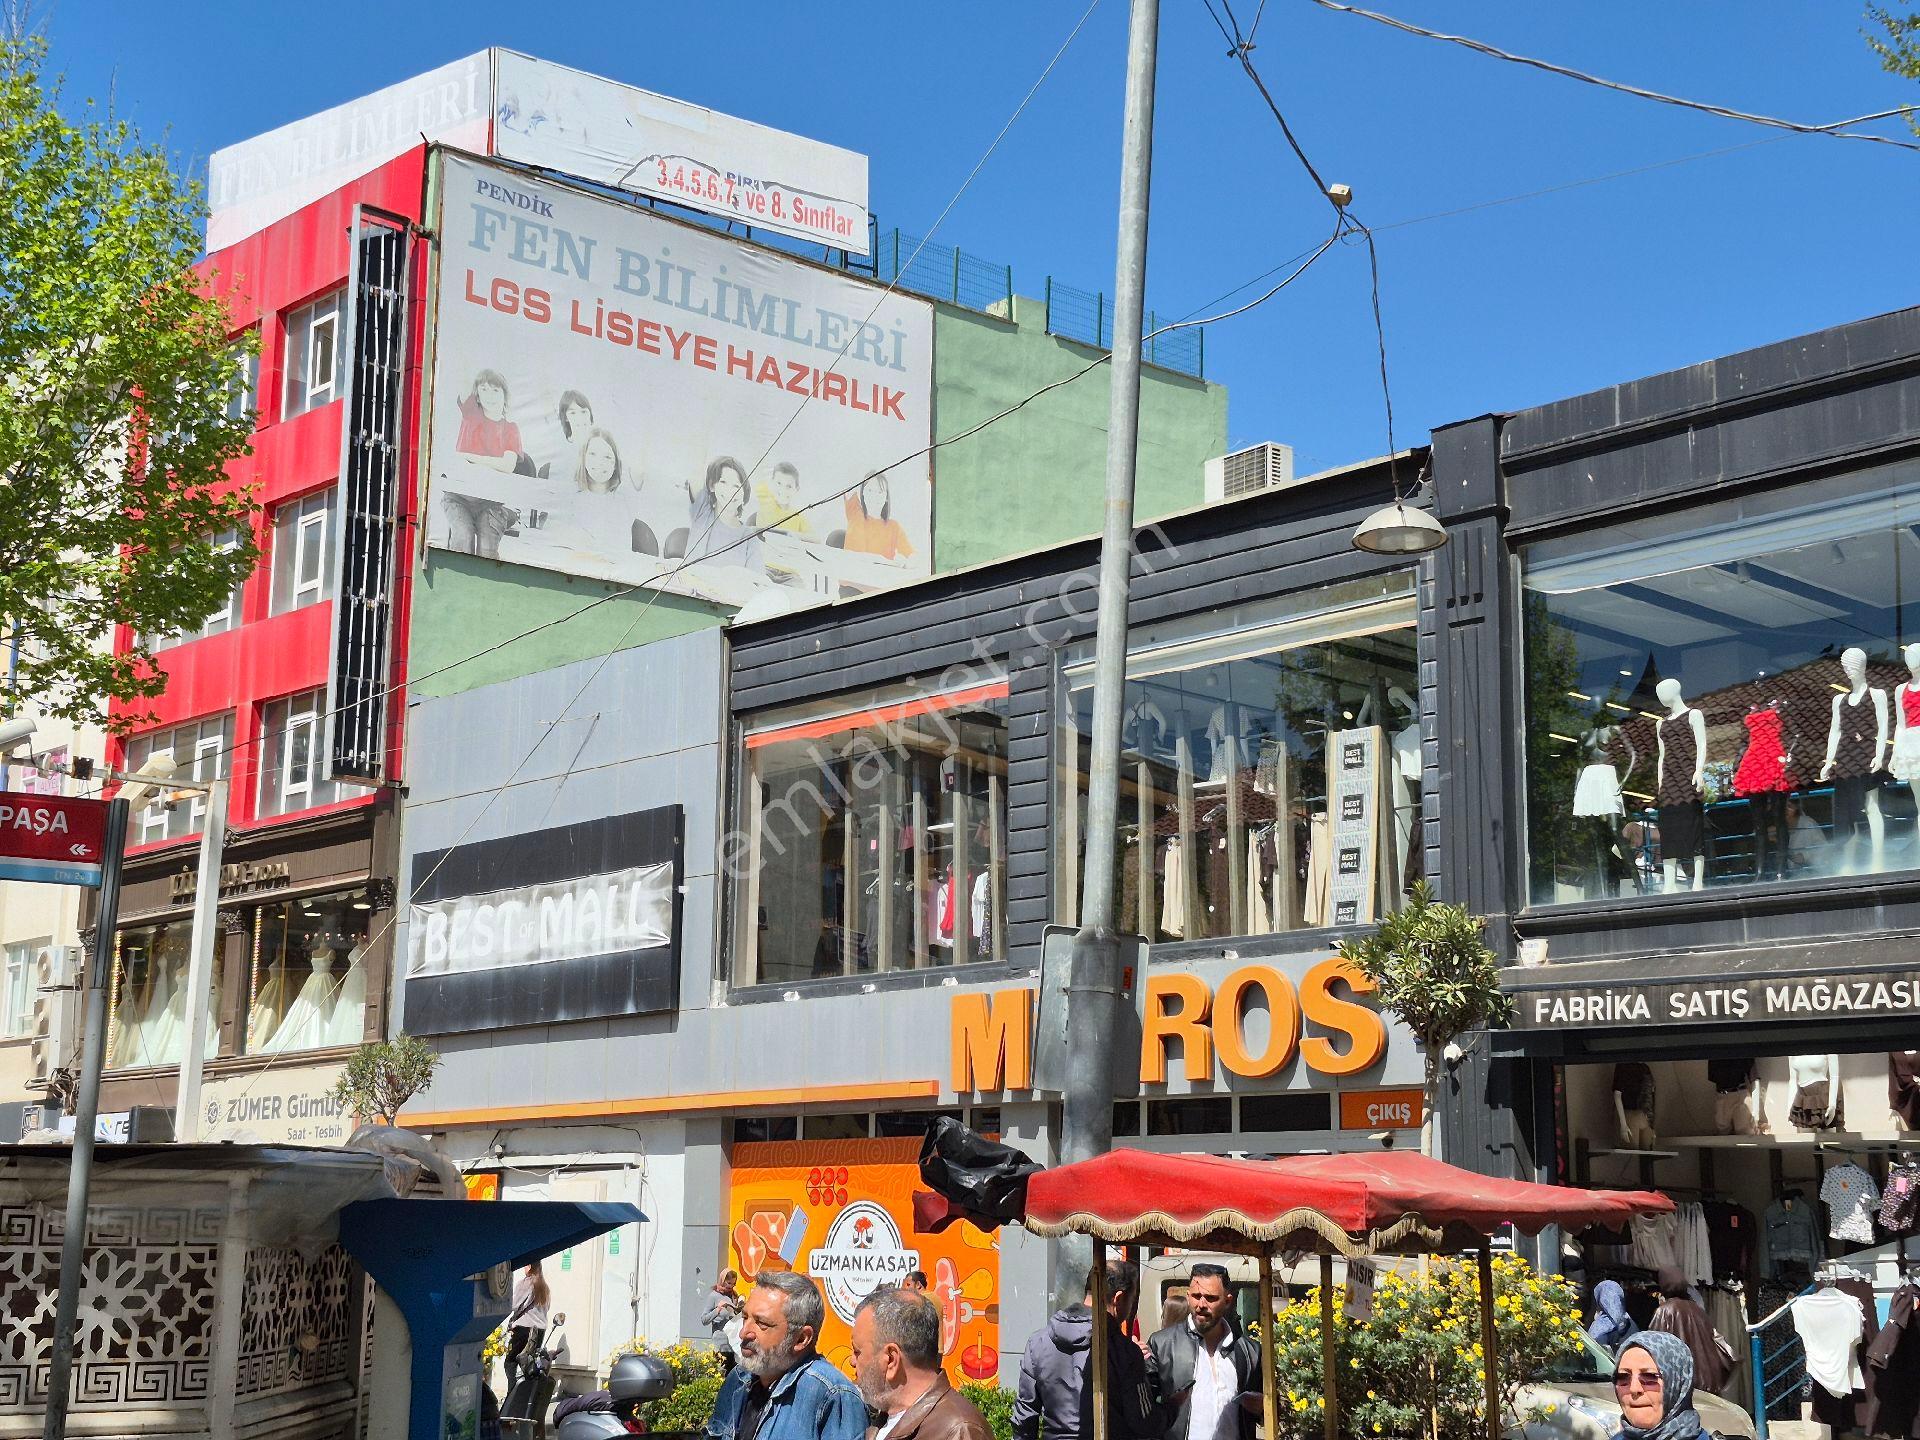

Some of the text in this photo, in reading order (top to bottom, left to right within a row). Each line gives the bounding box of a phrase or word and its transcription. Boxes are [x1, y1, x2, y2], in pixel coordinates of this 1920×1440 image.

[477, 179, 554, 219] PENDİK
[745, 191, 766, 214] ve
[771, 191, 787, 219] 8.
[792, 196, 854, 236] Sınıflar
[468, 203, 908, 373] FEN BİLİMLERİ
[465, 269, 906, 421] LGS LİSEYE HAZIRLIK
[0, 805, 69, 836] PAŞA
[1341, 853, 1358, 861] BEST
[424, 900, 524, 963] BEST
[538, 881, 650, 949] MALL
[1535, 989, 1651, 1023] FABRİKA
[1669, 988, 1749, 1018] SATIŞ
[951, 957, 1388, 1093] MROS
[227, 1092, 282, 1122] ZÜMER
[1367, 1102, 1411, 1125] ÇIKIŞ
[287, 1127, 306, 1140] Saat
[314, 1125, 343, 1139] Tesbih
